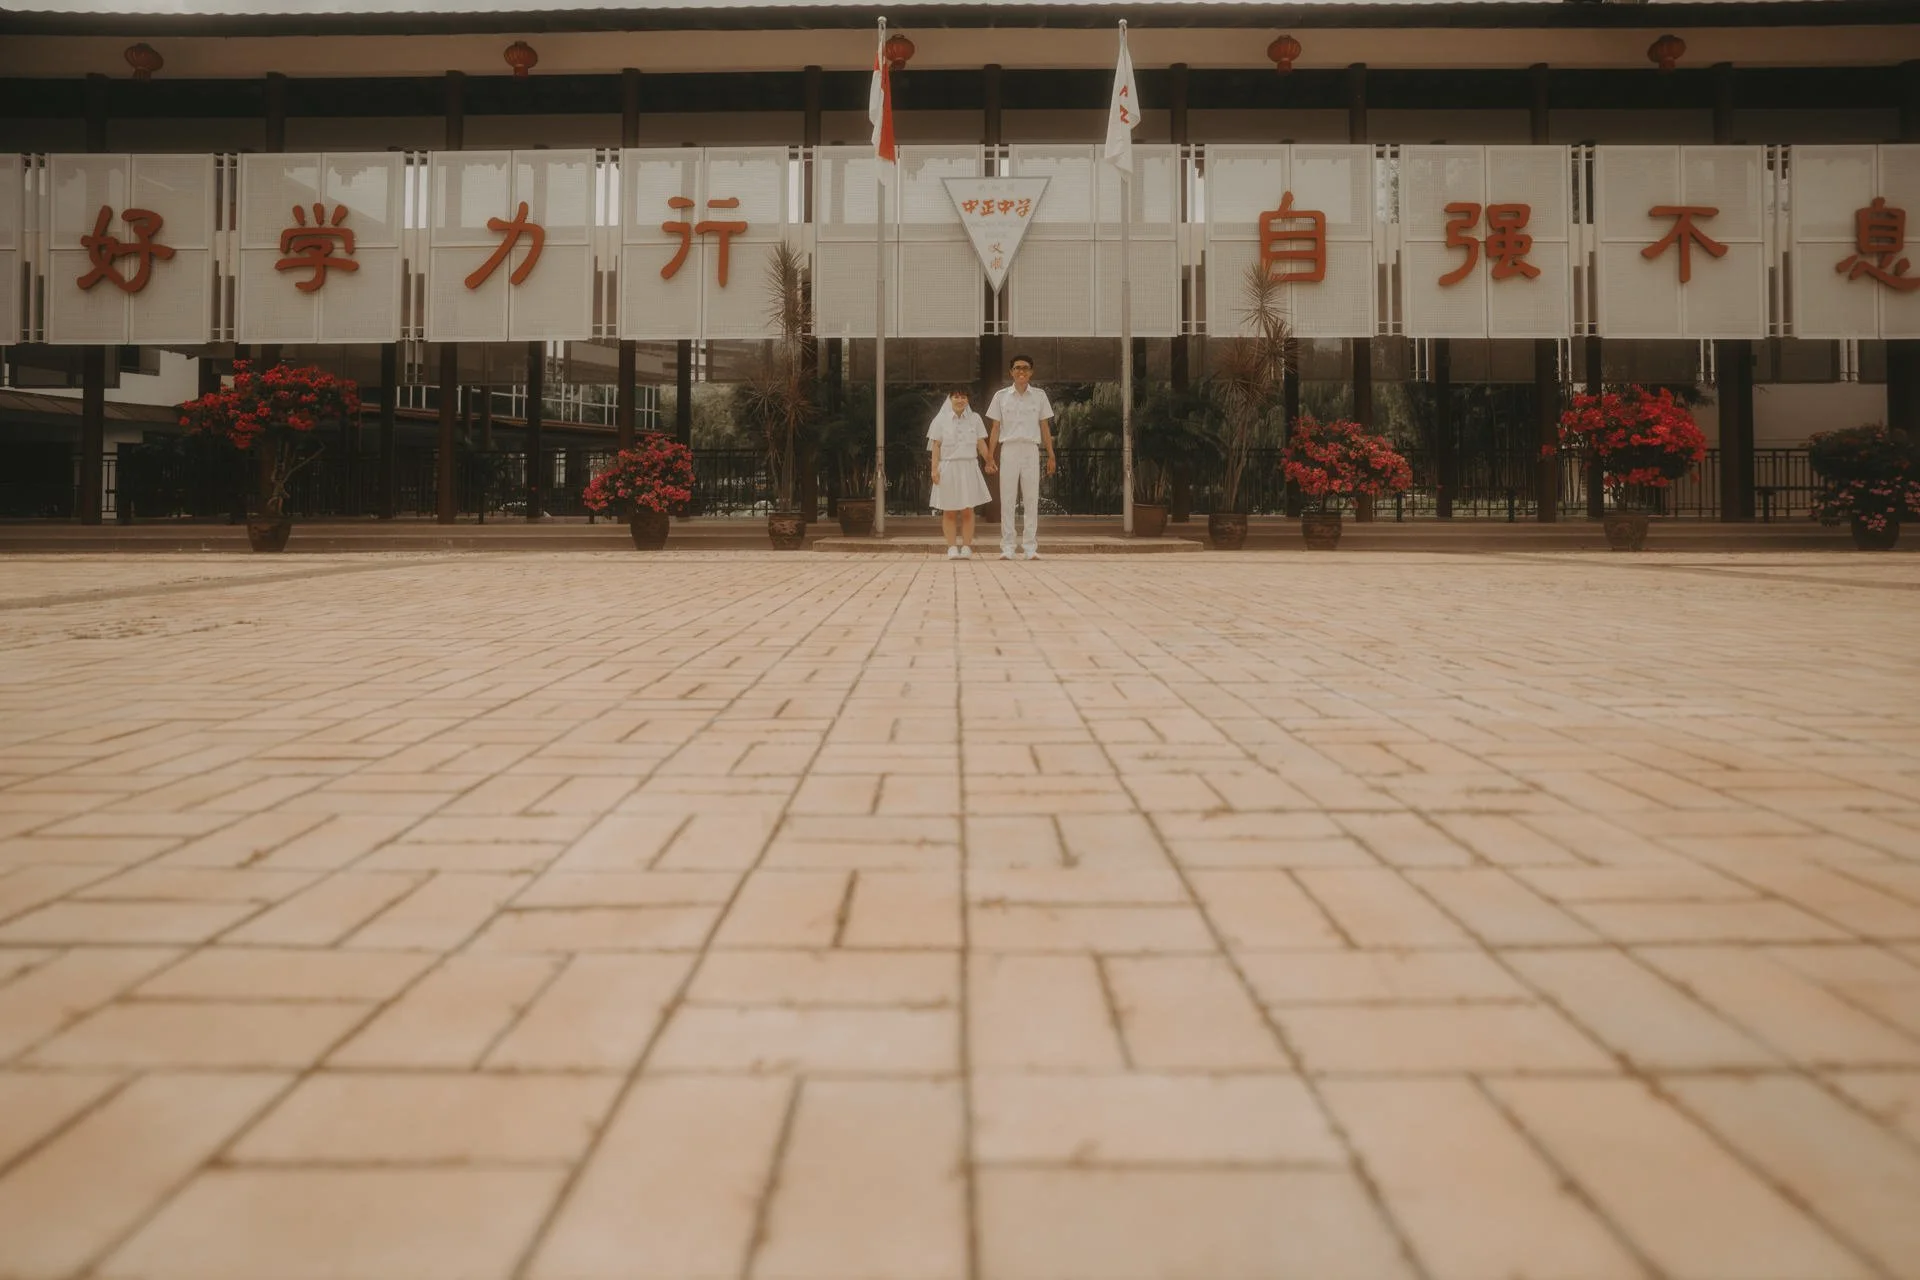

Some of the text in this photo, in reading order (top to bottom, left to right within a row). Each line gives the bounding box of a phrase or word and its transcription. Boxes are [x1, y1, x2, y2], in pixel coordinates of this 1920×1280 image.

[77, 196, 749, 293] 好学力行
[961, 198, 1032, 217] 中正中学
[1258, 190, 1920, 292] 自强不息
